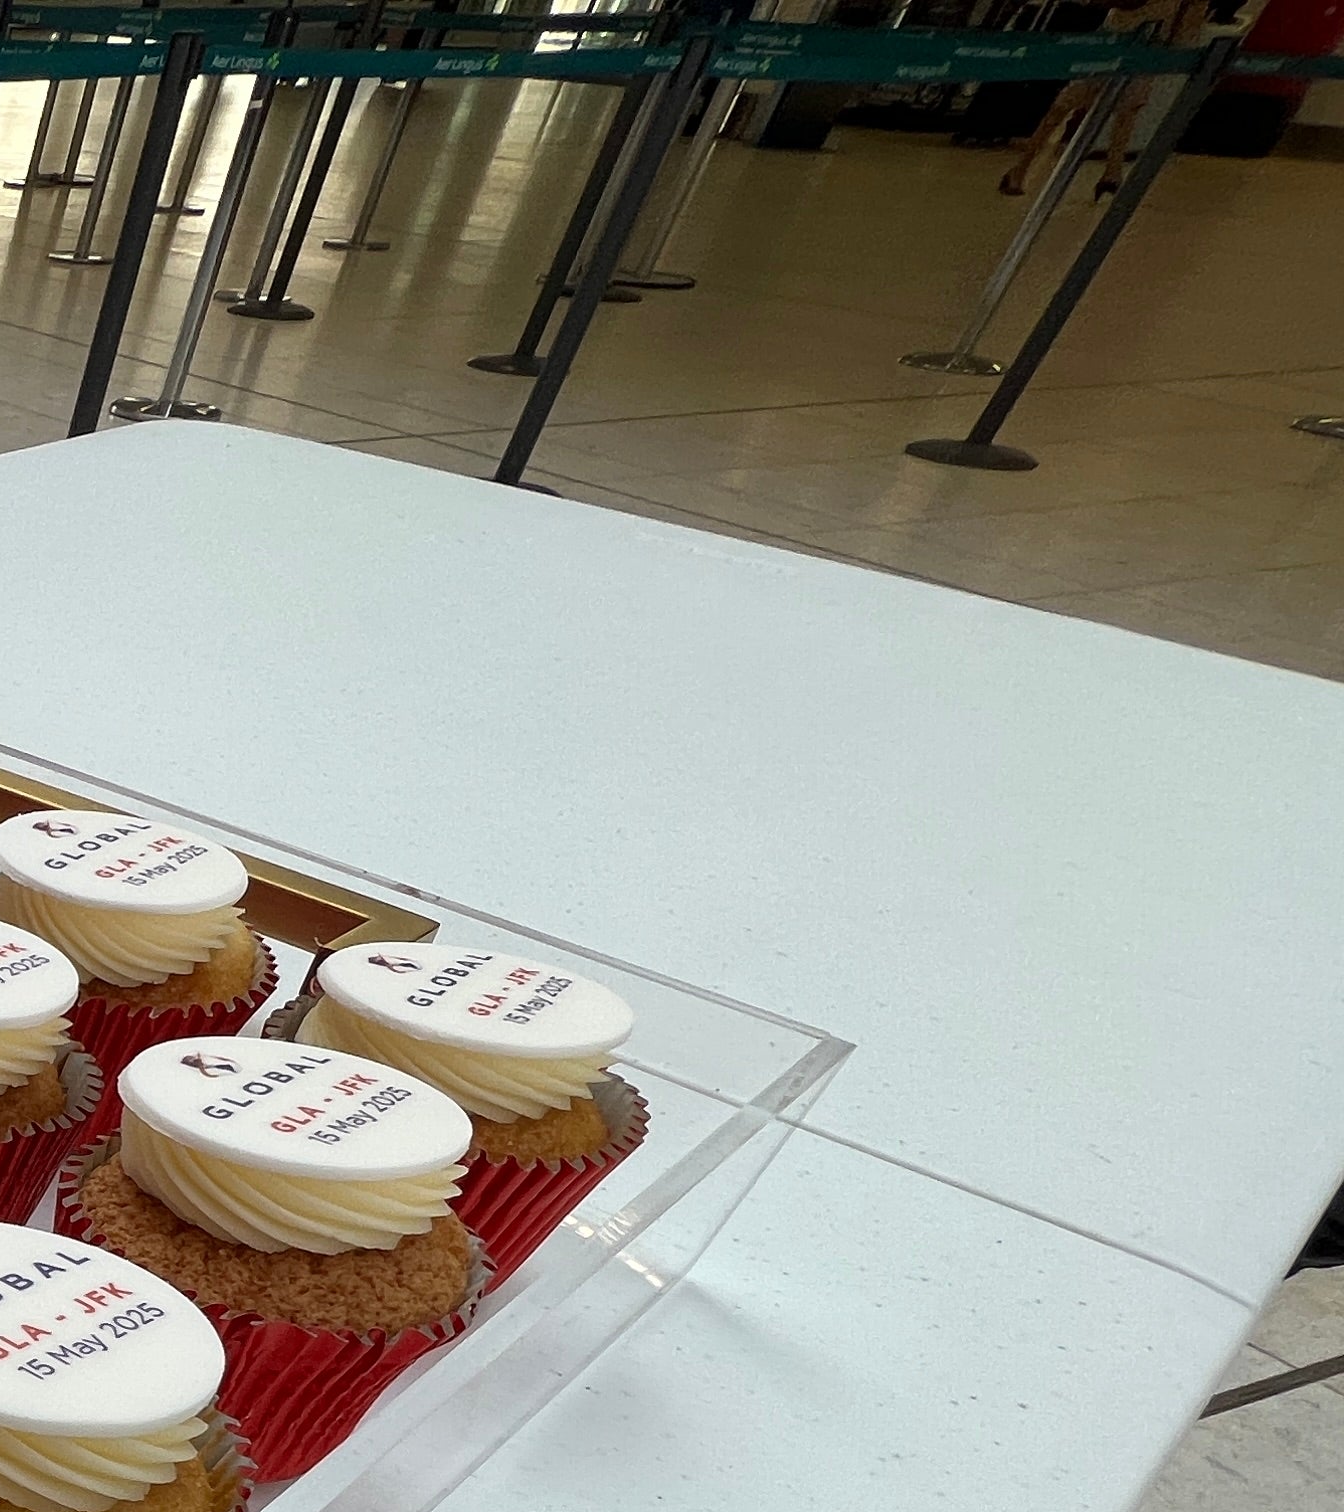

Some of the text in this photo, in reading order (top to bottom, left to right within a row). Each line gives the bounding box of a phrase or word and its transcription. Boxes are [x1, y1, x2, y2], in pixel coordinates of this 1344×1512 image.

[44, 824, 151, 869] GLOBAL
[95, 836, 183, 878] GLA JFK
[122, 845, 208, 886] 15 May 2025
[0, 954, 50, 976] 2025
[407, 955, 493, 1007] GLOBAL
[468, 968, 540, 1016] GLA JFK
[503, 976, 573, 1024] 15 May 2025
[202, 1056, 331, 1119] GLOBAL
[271, 1074, 379, 1133] GLA JFK
[308, 1086, 412, 1145] 15 May 2025
[73, 1282, 133, 1314] JFK
[17, 1302, 165, 1380] 15 May 2025
